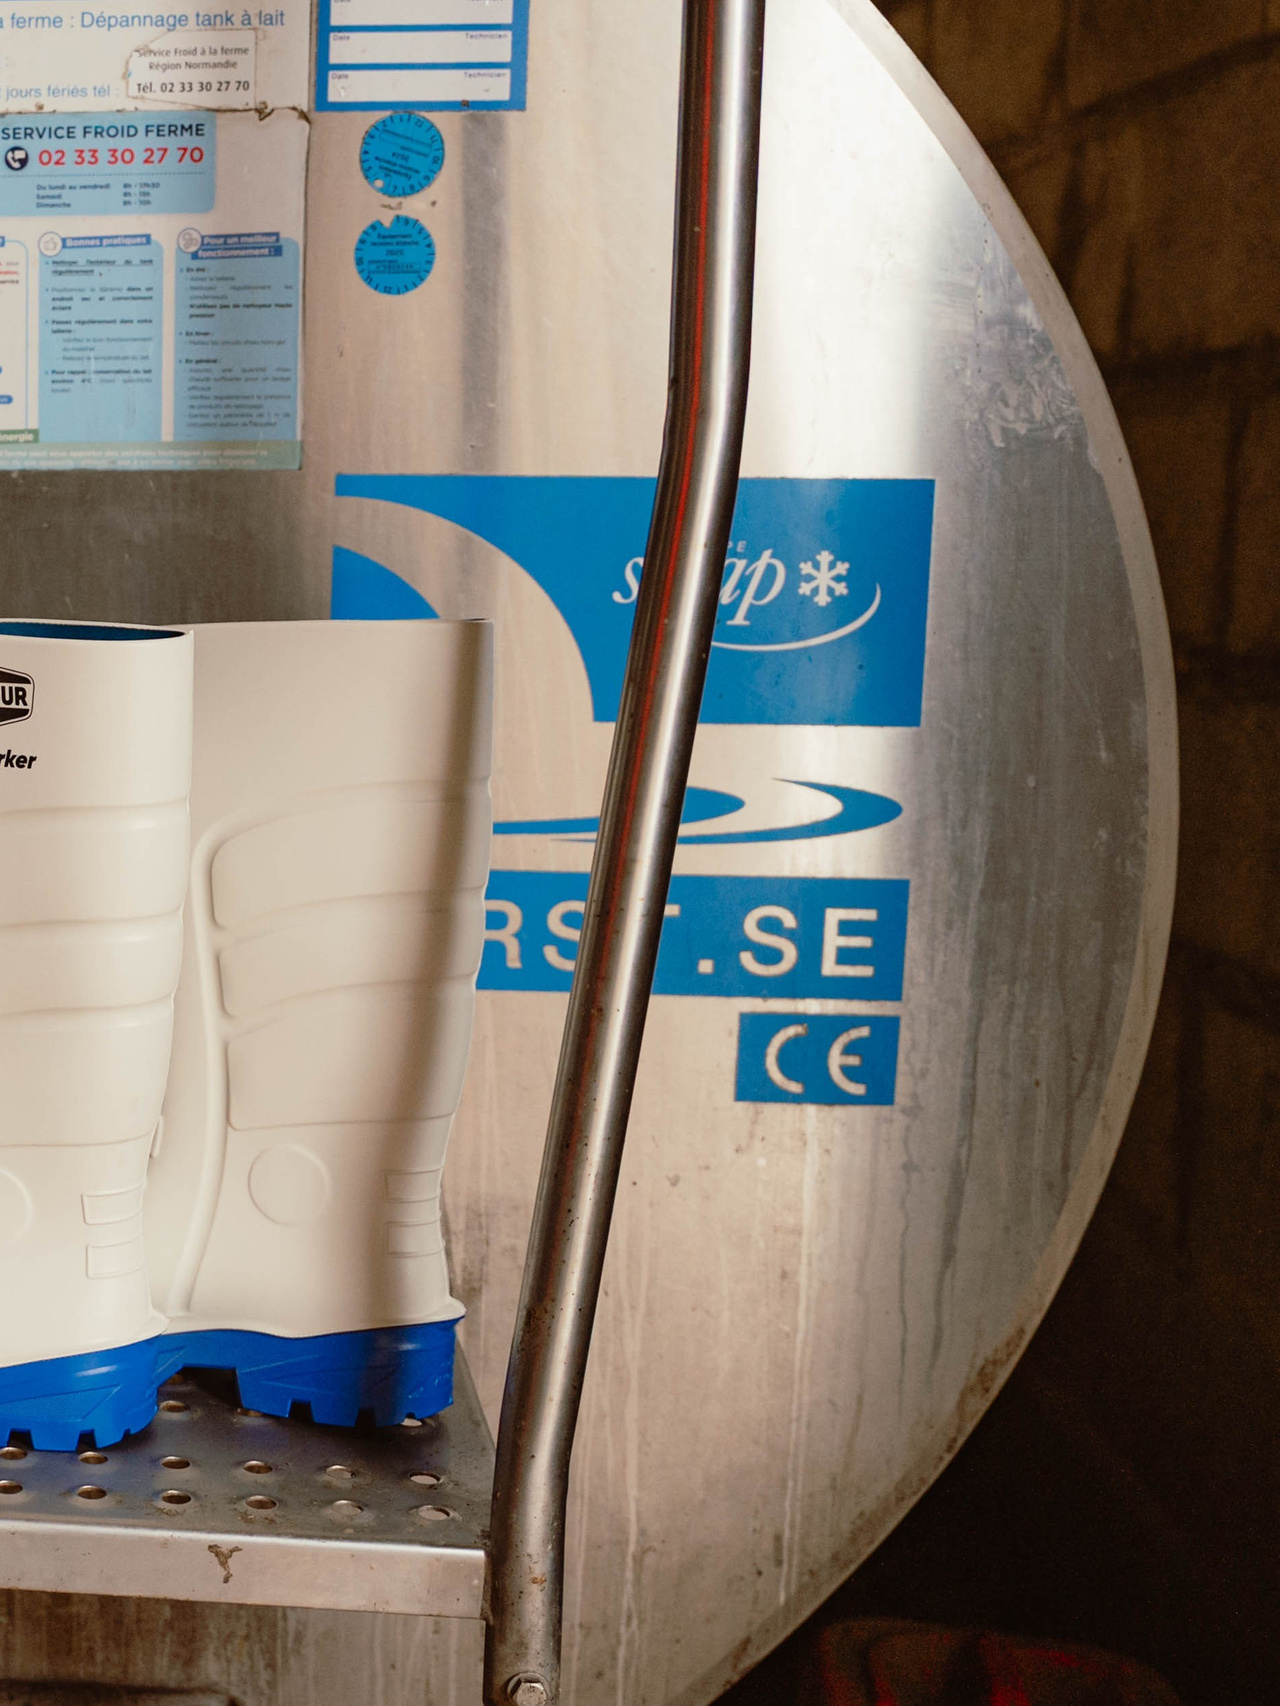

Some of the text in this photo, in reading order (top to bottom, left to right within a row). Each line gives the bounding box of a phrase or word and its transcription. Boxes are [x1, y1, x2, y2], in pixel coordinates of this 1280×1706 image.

[10, 12, 64, 29] ferme
[81, 11, 188, 32] Dépannage
[195, 10, 234, 28] tank
[241, 10, 252, 27] à
[258, 10, 285, 27] lait
[332, 32, 508, 42] Date Technicien
[174, 46, 198, 57] Froid
[200, 46, 206, 56] à
[208, 46, 218, 56] la
[220, 46, 250, 56] ferme
[148, 60, 238, 72] Région Normandie
[332, 70, 506, 80] Date Technicien
[6, 86, 42, 102] jours
[47, 84, 88, 98] fériés
[93, 84, 110, 97] tél
[136, 80, 250, 94] Tél. 02 33 30 27 70
[1, 124, 206, 140] SERVICE FROID FERME
[38, 146, 204, 166] 02 33 30 27 70
[66, 236, 146, 248] Bonnes pratiques
[204, 236, 225, 244] Pour
[240, 234, 278, 244] meilleur
[198, 248, 269, 258] fonctionnement
[765, 1023, 872, 1096] CE
